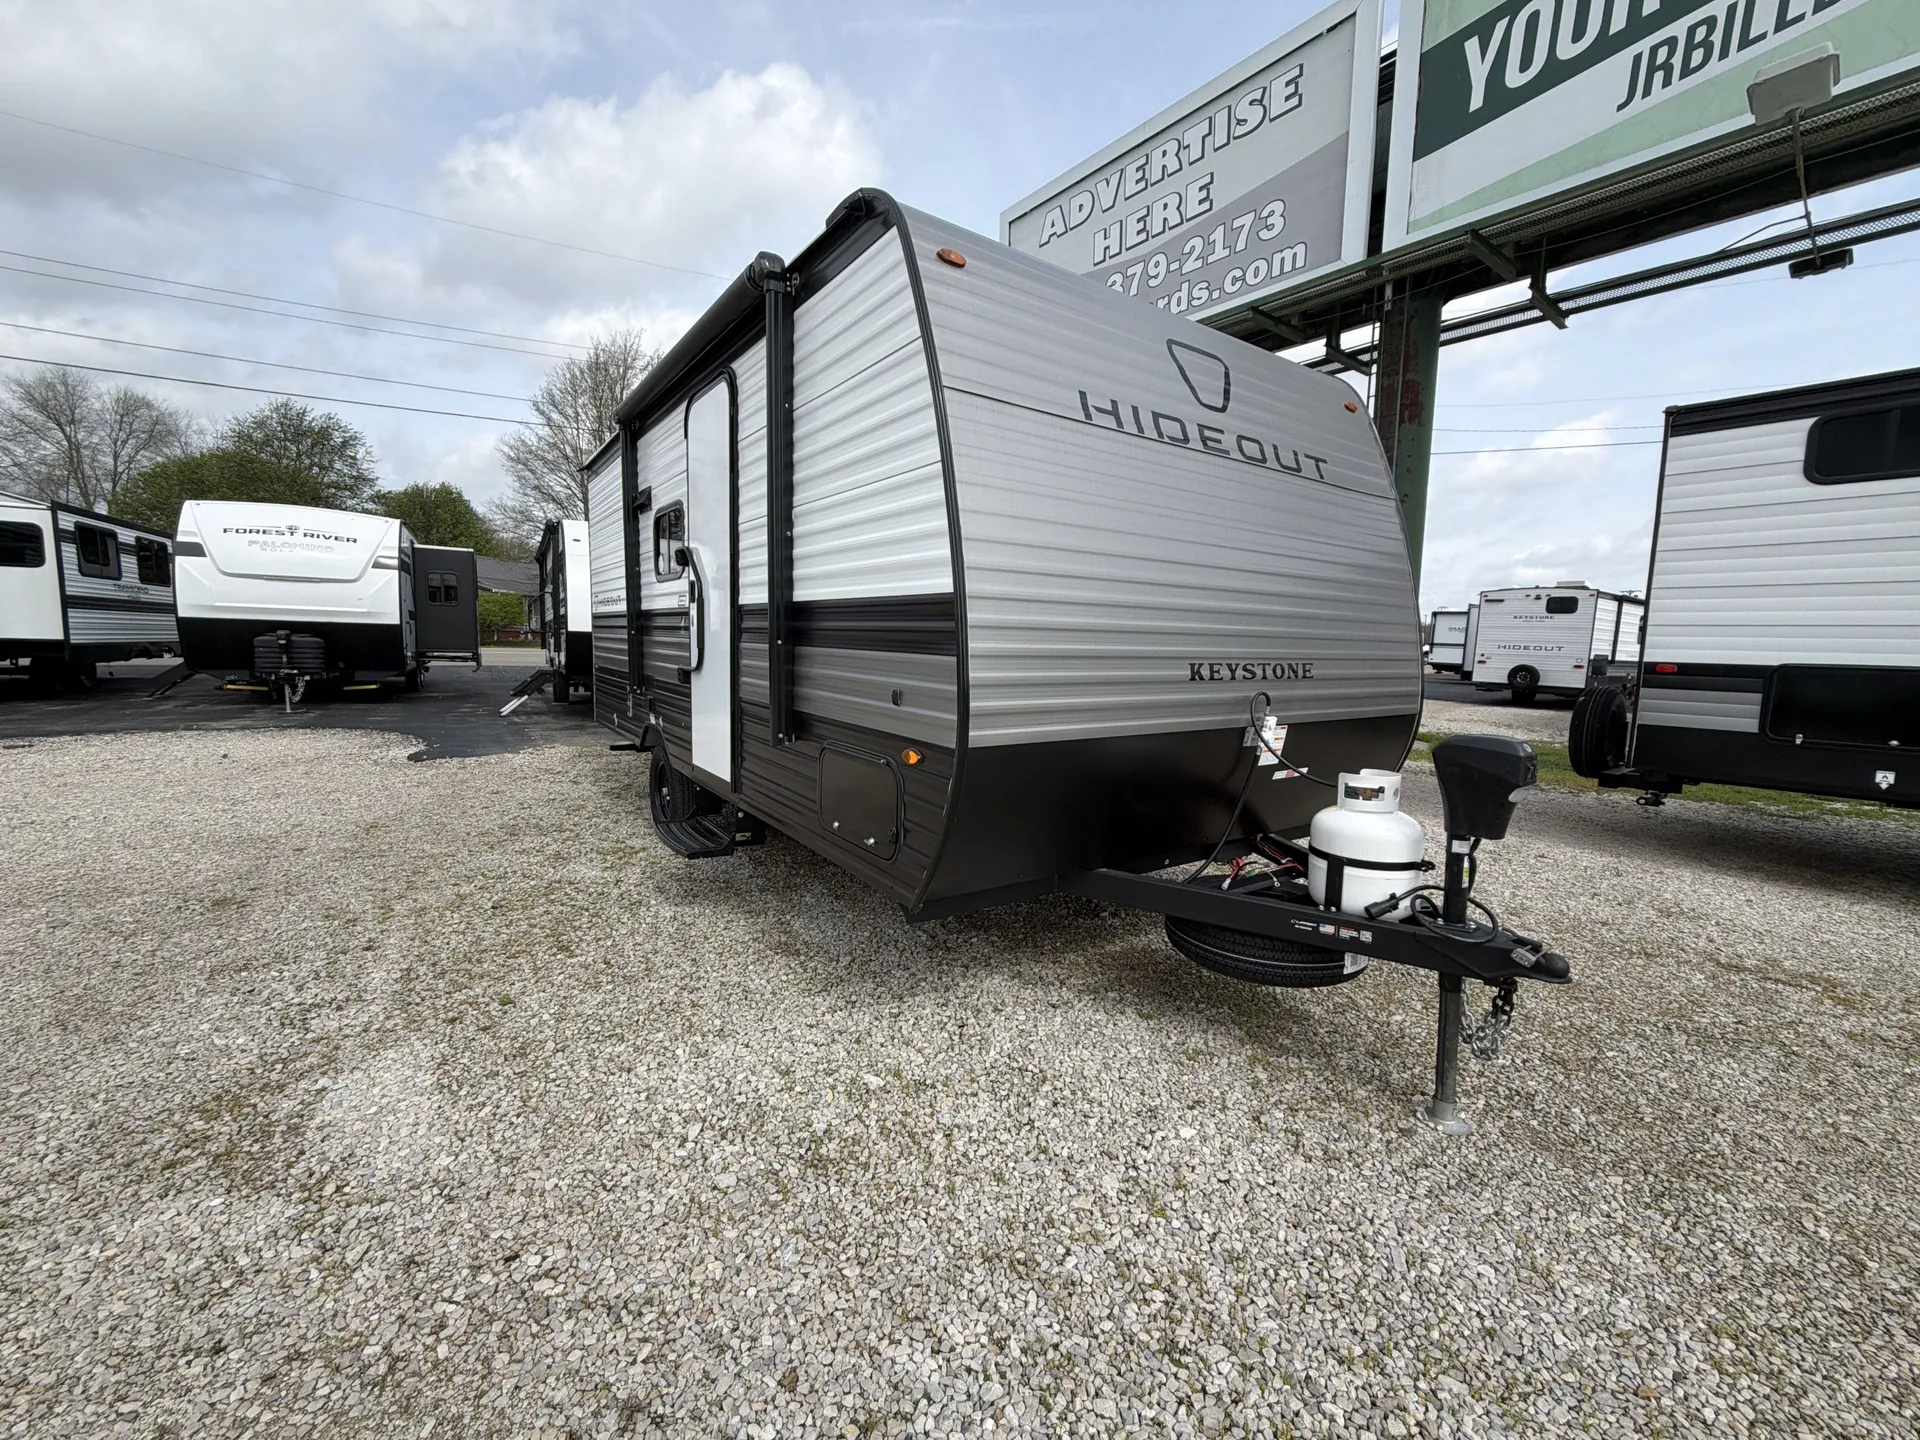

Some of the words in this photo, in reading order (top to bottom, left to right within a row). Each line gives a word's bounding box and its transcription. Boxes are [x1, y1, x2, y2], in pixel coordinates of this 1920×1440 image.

[1616, 0, 1842, 113] JRBILL
[1039, 63, 1303, 247] ADVERTISE
[1093, 171, 1214, 266] HERE
[1150, 241, 1307, 315] rds.com
[1078, 389, 1329, 480] HIDEOUT
[222, 527, 299, 536] FOREST
[303, 531, 358, 543] RIVER
[247, 539, 335, 554] PALOMINO
[1188, 662, 1314, 682] KEYSTONE
[1497, 644, 1565, 652] HIDEOUT
